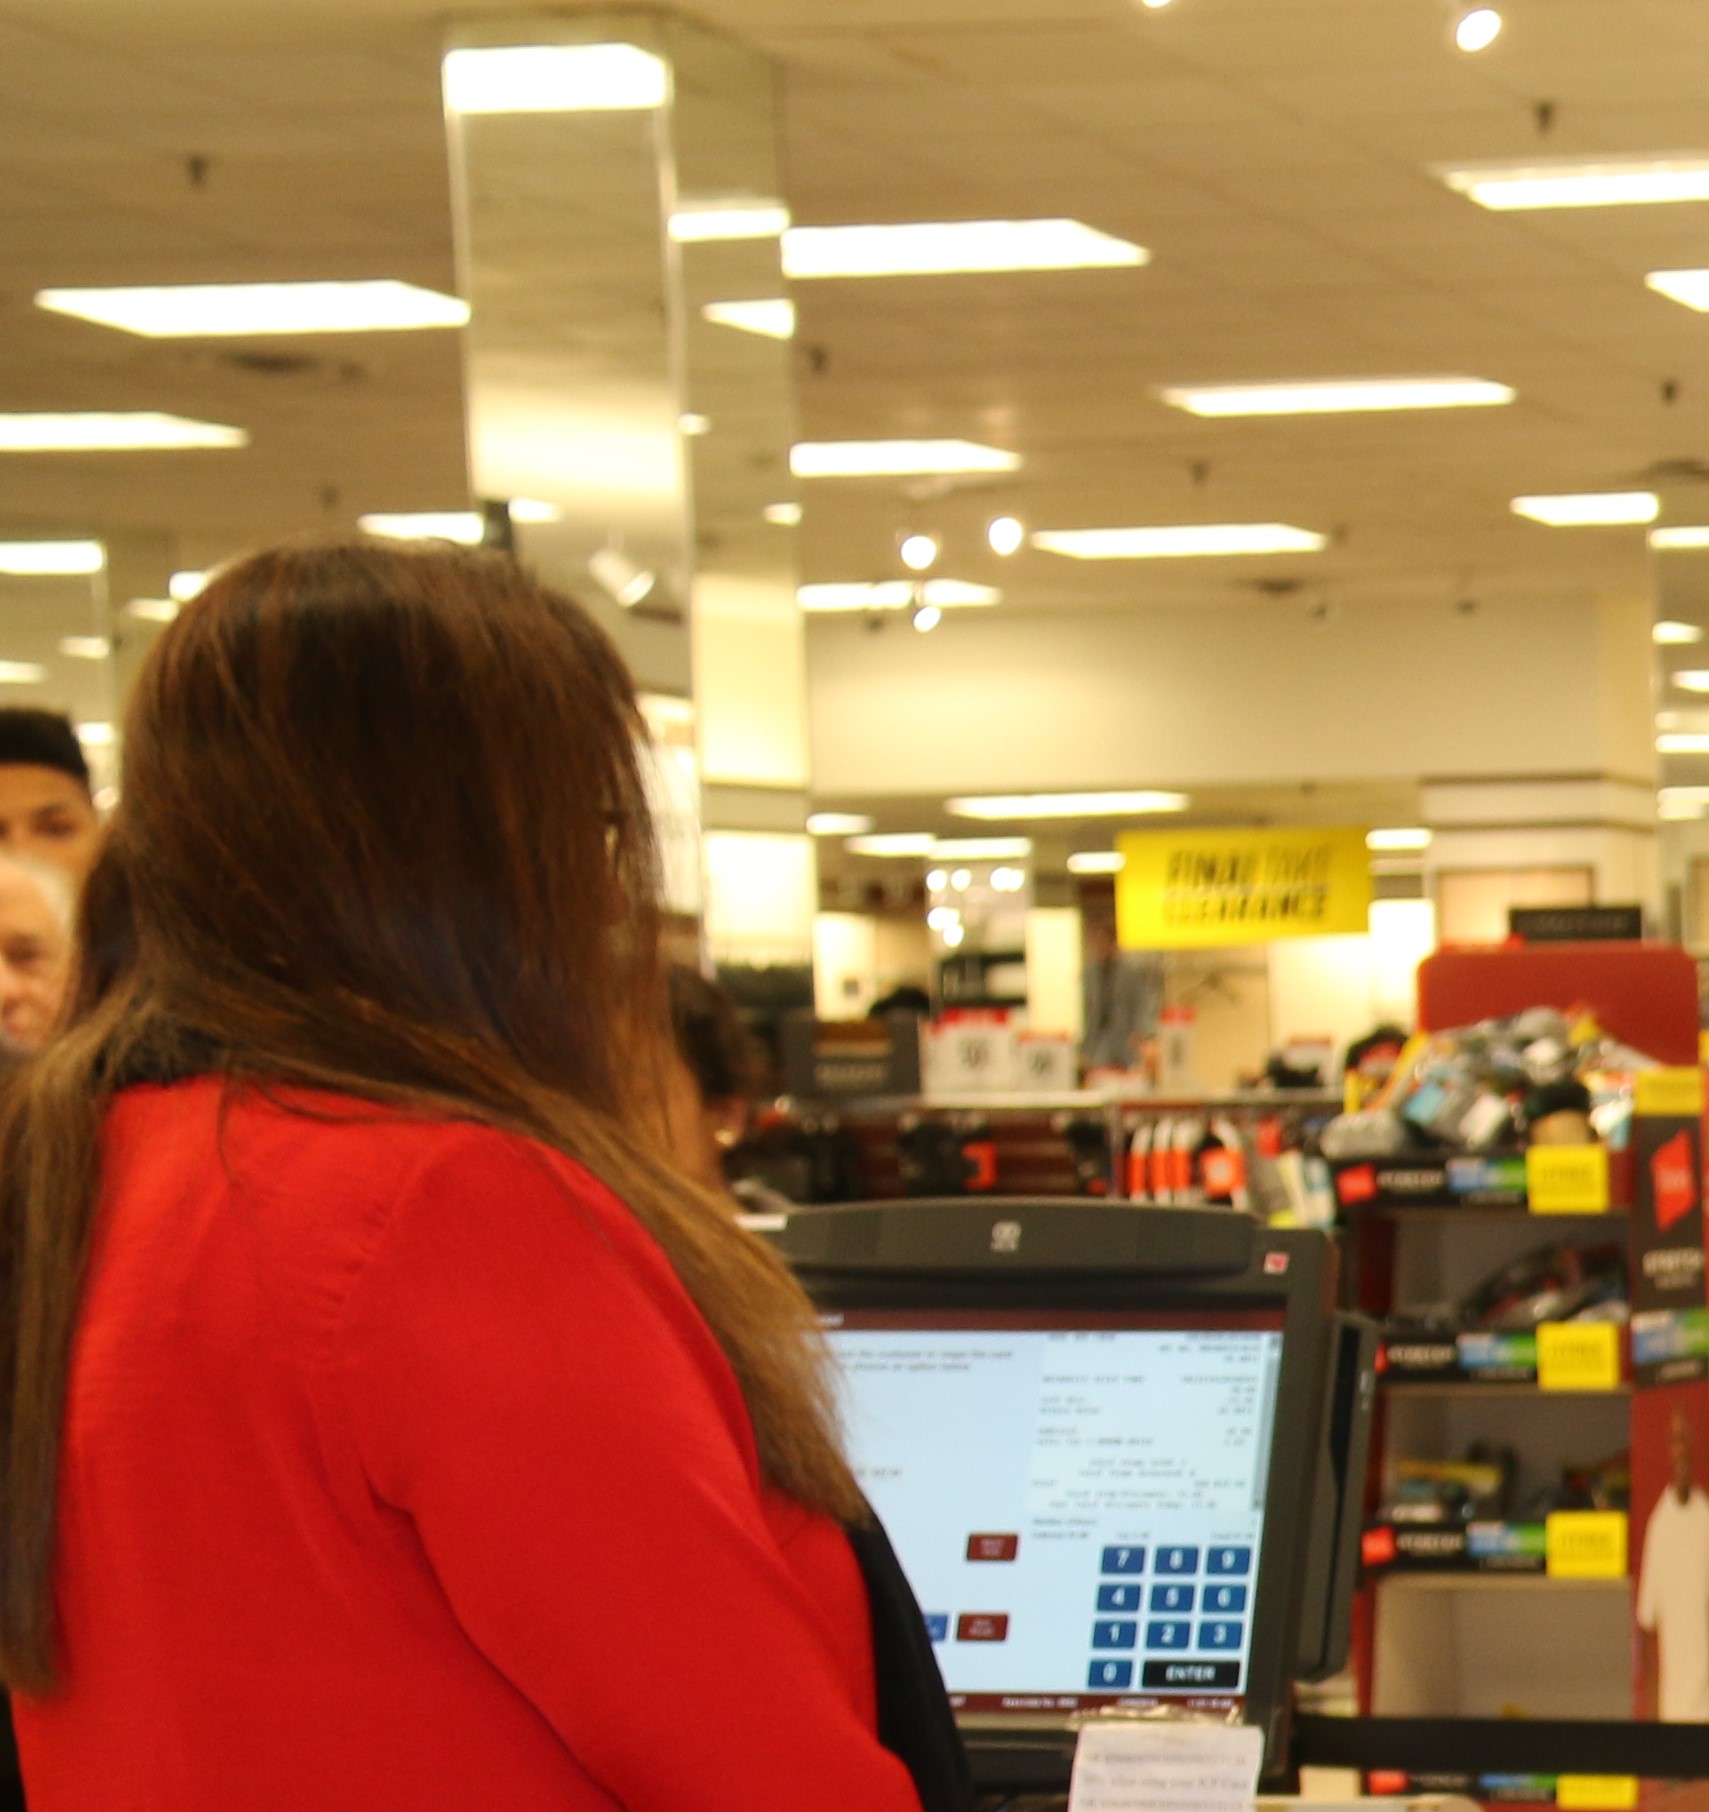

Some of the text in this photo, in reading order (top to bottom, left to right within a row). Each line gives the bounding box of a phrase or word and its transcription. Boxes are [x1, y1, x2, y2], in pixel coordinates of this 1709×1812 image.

[1116, 1548, 1131, 1570] 7
[1111, 1586, 1126, 1607] 4
[1108, 1622, 1228, 1645] 1 2 3
[1164, 1665, 1217, 1682] ENTER
